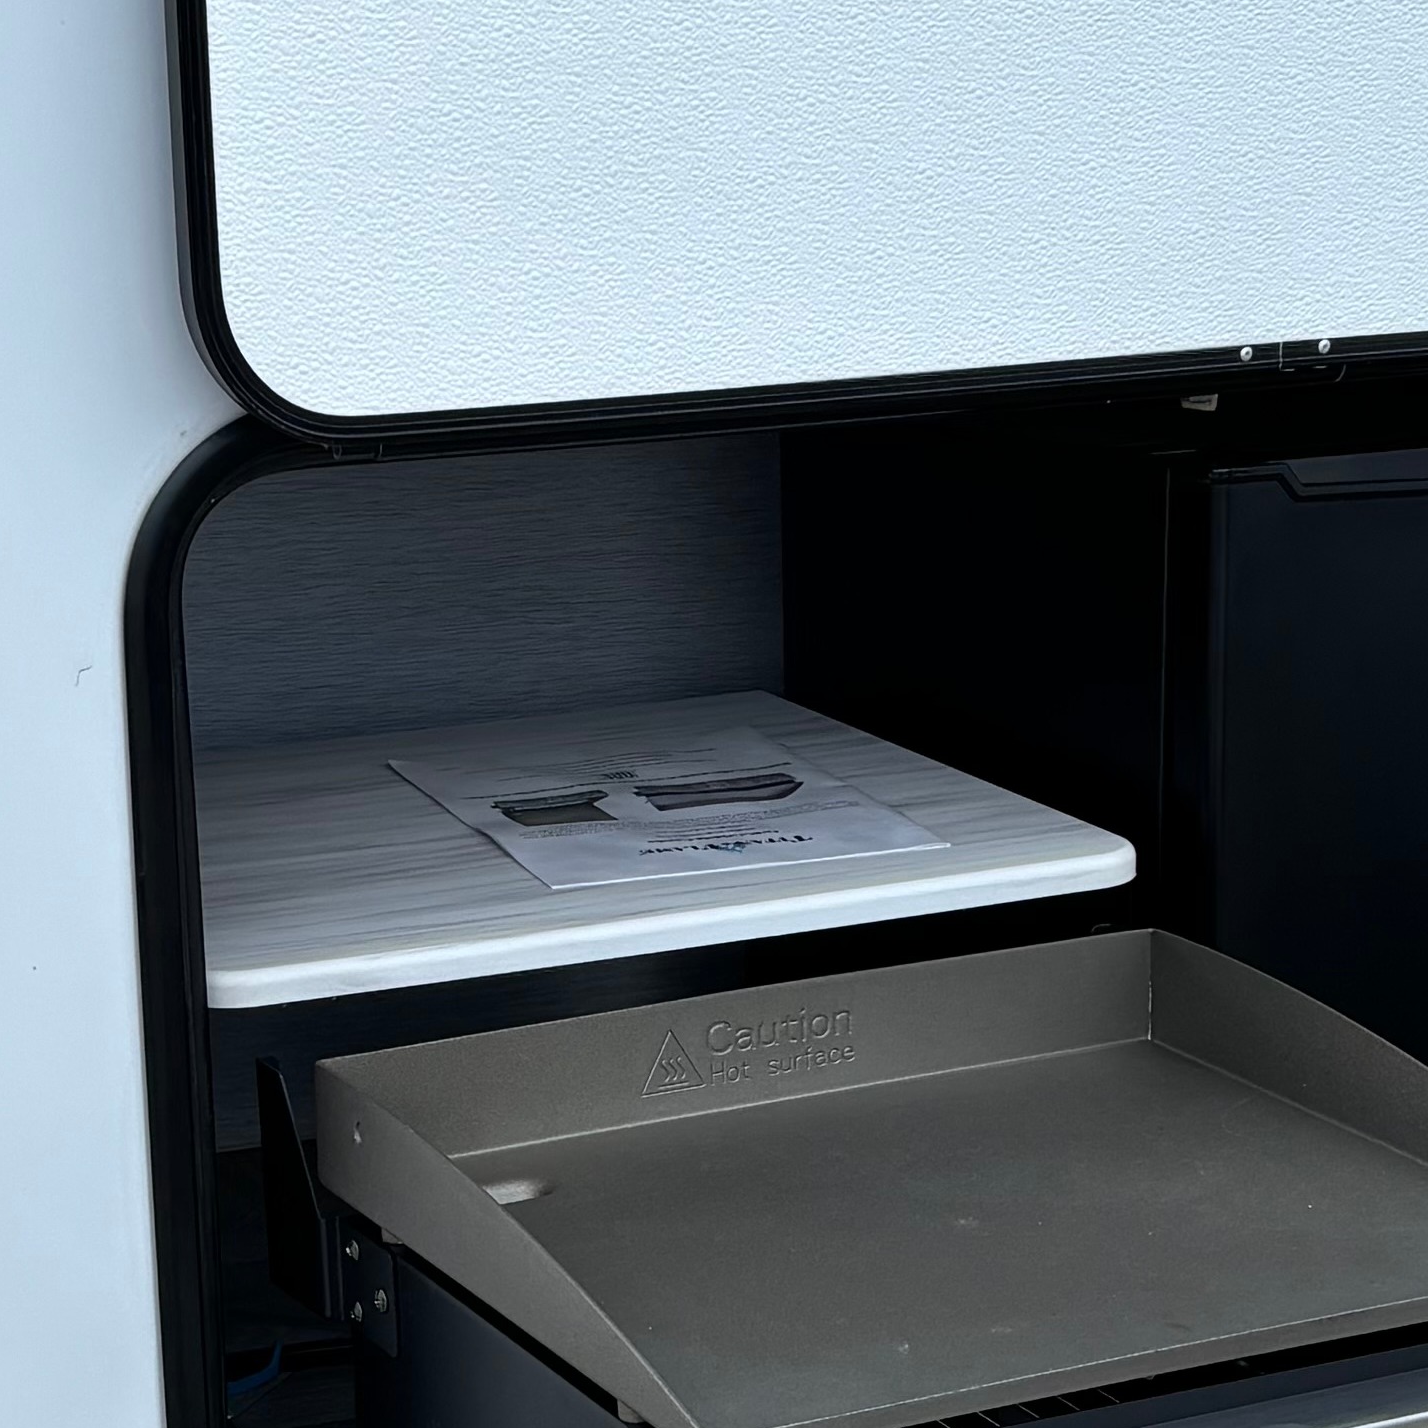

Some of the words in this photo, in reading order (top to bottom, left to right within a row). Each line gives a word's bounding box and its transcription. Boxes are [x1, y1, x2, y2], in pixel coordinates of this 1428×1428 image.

[706, 1008, 853, 1056] Caution
[710, 1062, 752, 1086] Hot
[767, 1046, 856, 1077] surface
